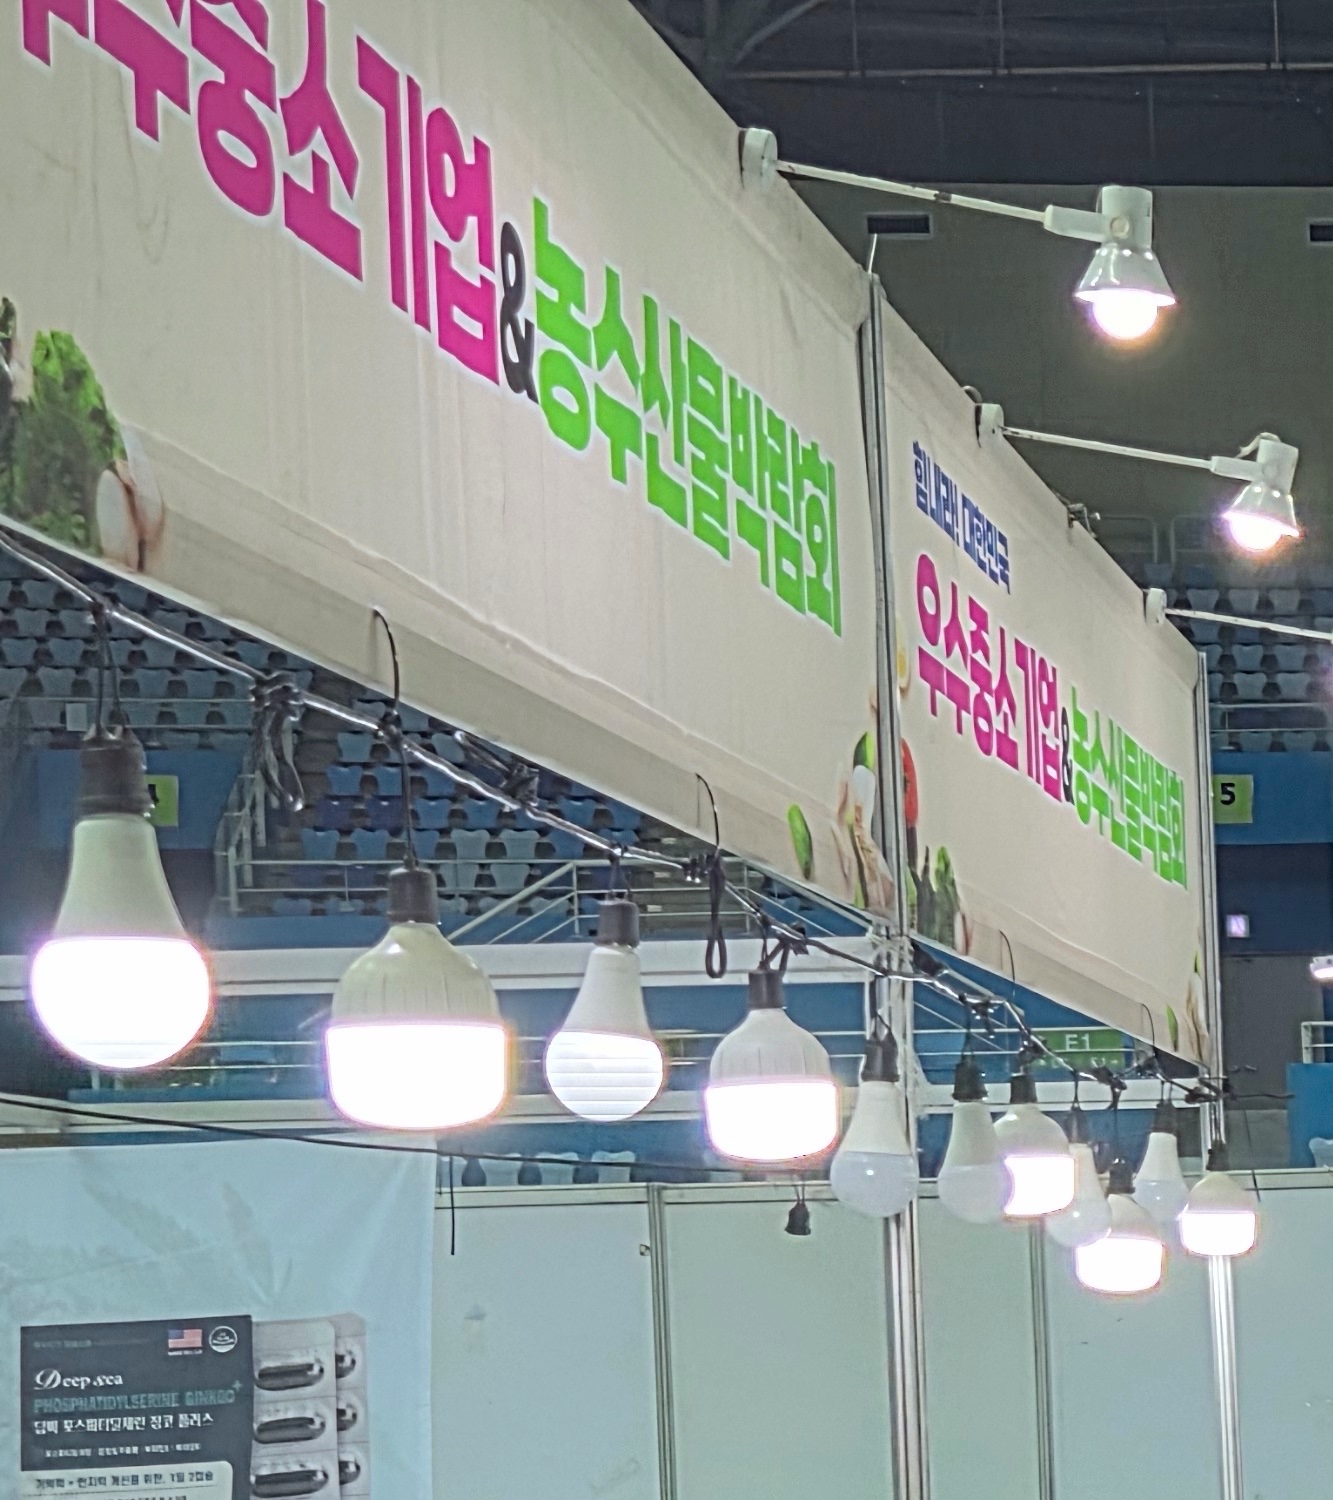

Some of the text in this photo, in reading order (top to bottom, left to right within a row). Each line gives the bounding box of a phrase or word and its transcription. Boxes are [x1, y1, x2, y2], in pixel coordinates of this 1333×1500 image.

[961, 493, 1011, 595] 대한민국
[1220, 782, 1236, 805] 5
[1065, 1033, 1090, 1051] E1
[34, 1368, 92, 1390] Deep
